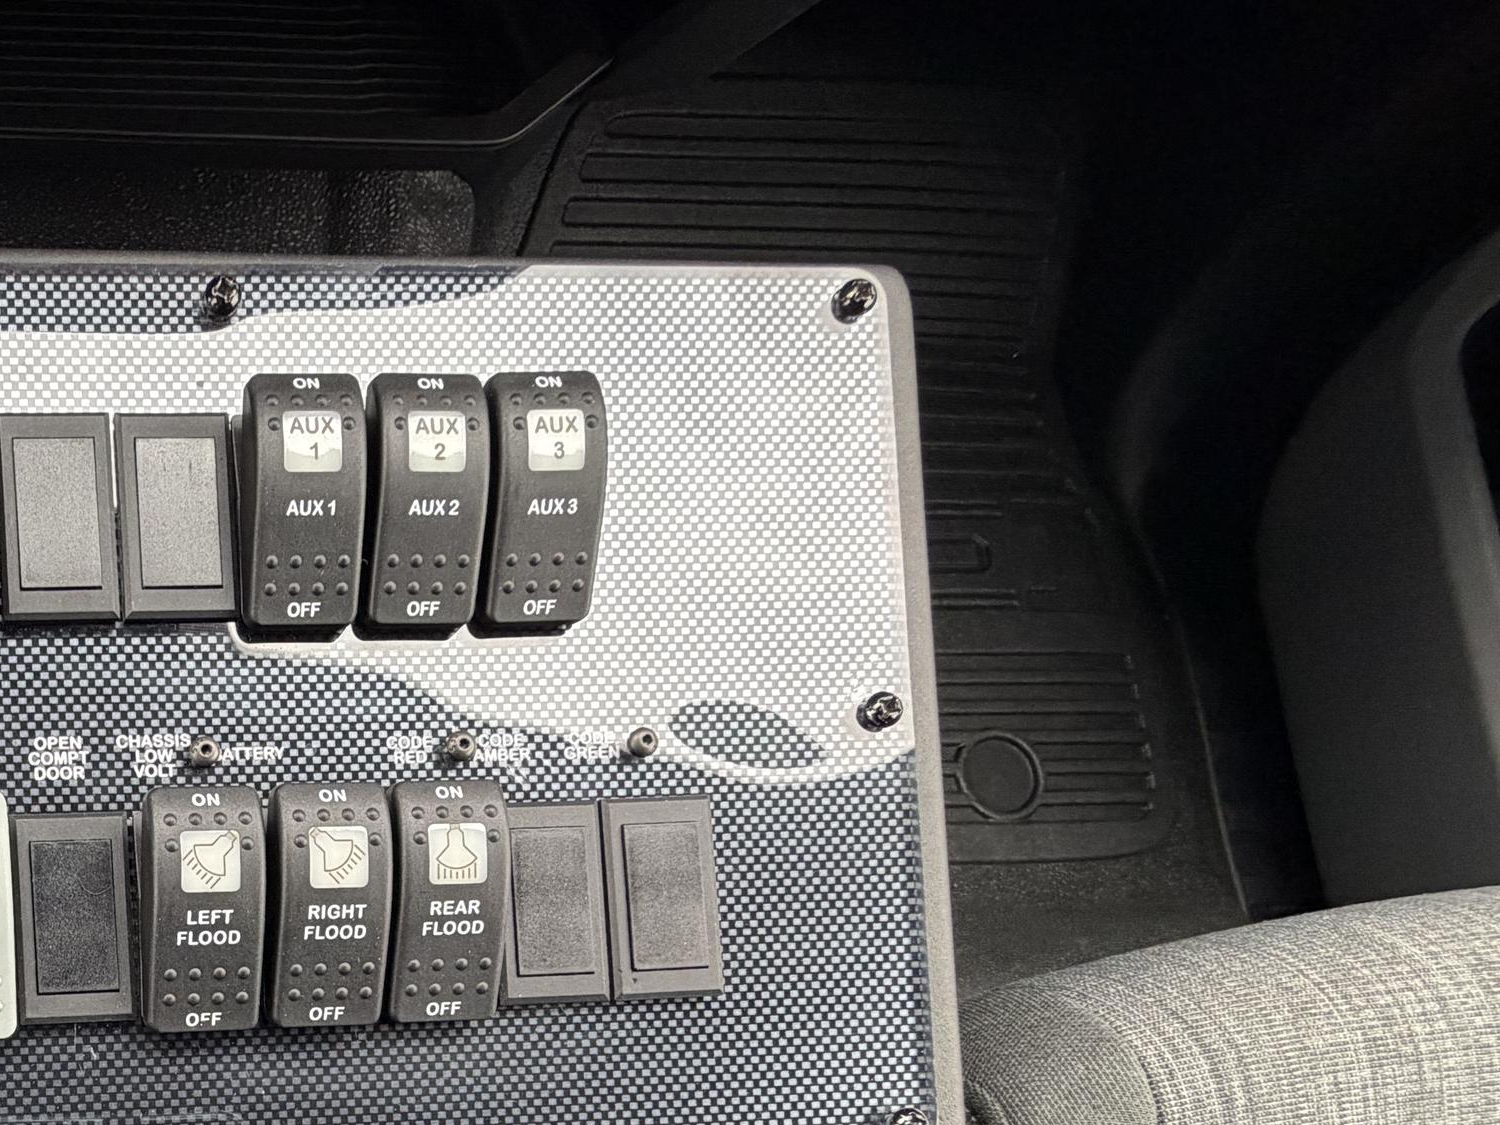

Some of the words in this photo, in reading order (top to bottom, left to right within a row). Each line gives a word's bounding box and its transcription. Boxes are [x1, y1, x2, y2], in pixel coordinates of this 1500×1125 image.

[292, 377, 320, 390] ON
[416, 377, 444, 390] ON
[534, 376, 563, 388] ON
[289, 416, 335, 435] AUX
[414, 416, 459, 435] AUX
[534, 415, 579, 434] AUX
[308, 442, 320, 461] 1
[434, 443, 447, 461] 2
[553, 442, 566, 460] 3
[285, 499, 324, 517] AUX
[327, 499, 337, 516] 1
[408, 499, 446, 517] AUX
[448, 499, 460, 517] 2
[527, 499, 565, 516] AUX
[566, 498, 579, 516] 3
[286, 602, 321, 619] OFF
[406, 601, 441, 617] OFF
[522, 599, 557, 616] OFF
[33, 736, 83, 750] OPEN
[115, 733, 192, 749] CHASSIS
[386, 735, 433, 750] CODE
[477, 732, 525, 748] CODE
[567, 731, 615, 746] CODE
[28, 750, 90, 766] COMPT
[135, 749, 174, 763] LOW
[218, 745, 285, 762] ATTERY
[393, 750, 428, 764] RED
[473, 748, 531, 763] AMBER
[563, 746, 621, 760] GREEN
[33, 765, 86, 780] DOOR
[133, 763, 177, 778] VOLT
[191, 793, 220, 807] ON
[318, 789, 347, 803] ON
[435, 785, 464, 799] ON
[307, 903, 368, 920] RIGHT
[429, 899, 481, 916] REAR
[185, 909, 235, 926] LEFT
[303, 924, 367, 941] FLOOD
[421, 919, 485, 937] FLOOD
[176, 930, 242, 946] FLOOD
[308, 1006, 346, 1021] OFF
[425, 1001, 462, 1017] OFF
[185, 1012, 223, 1027] OFF
